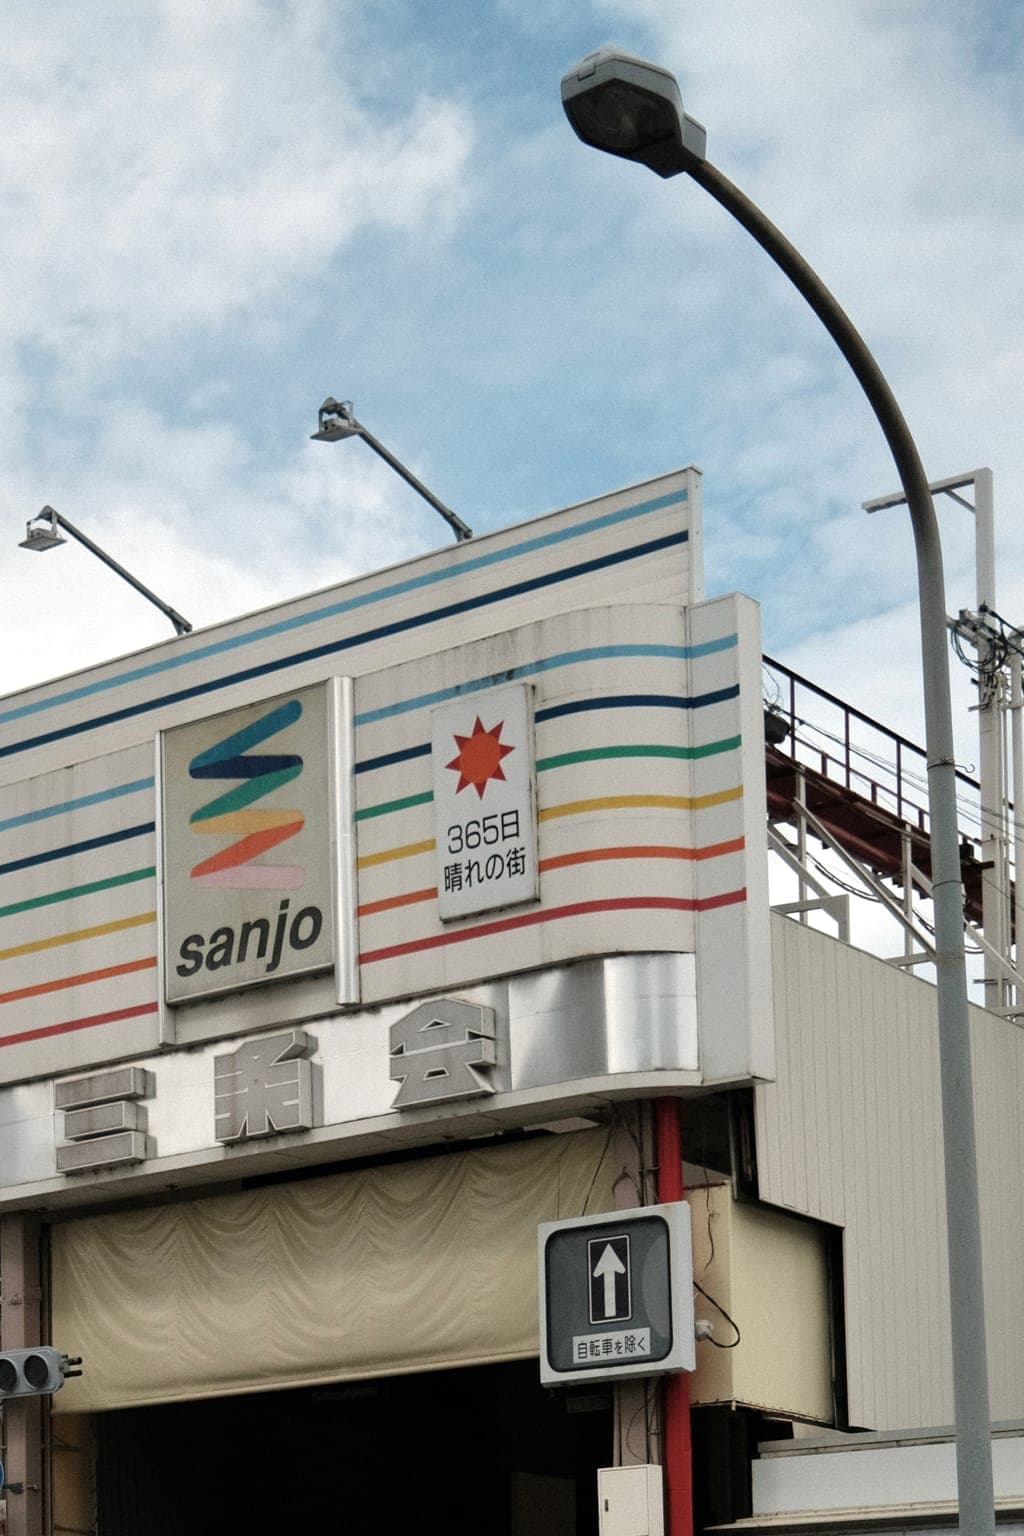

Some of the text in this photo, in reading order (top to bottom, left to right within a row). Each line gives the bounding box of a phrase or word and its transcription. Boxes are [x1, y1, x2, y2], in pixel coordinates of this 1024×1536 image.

[447, 809, 520, 855] 365日
[443, 846, 526, 893] 晴れの街
[176, 898, 323, 977] sanjo
[54, 998, 496, 1175] 三条会
[577, 1334, 646, 1359] 自転車を除く
